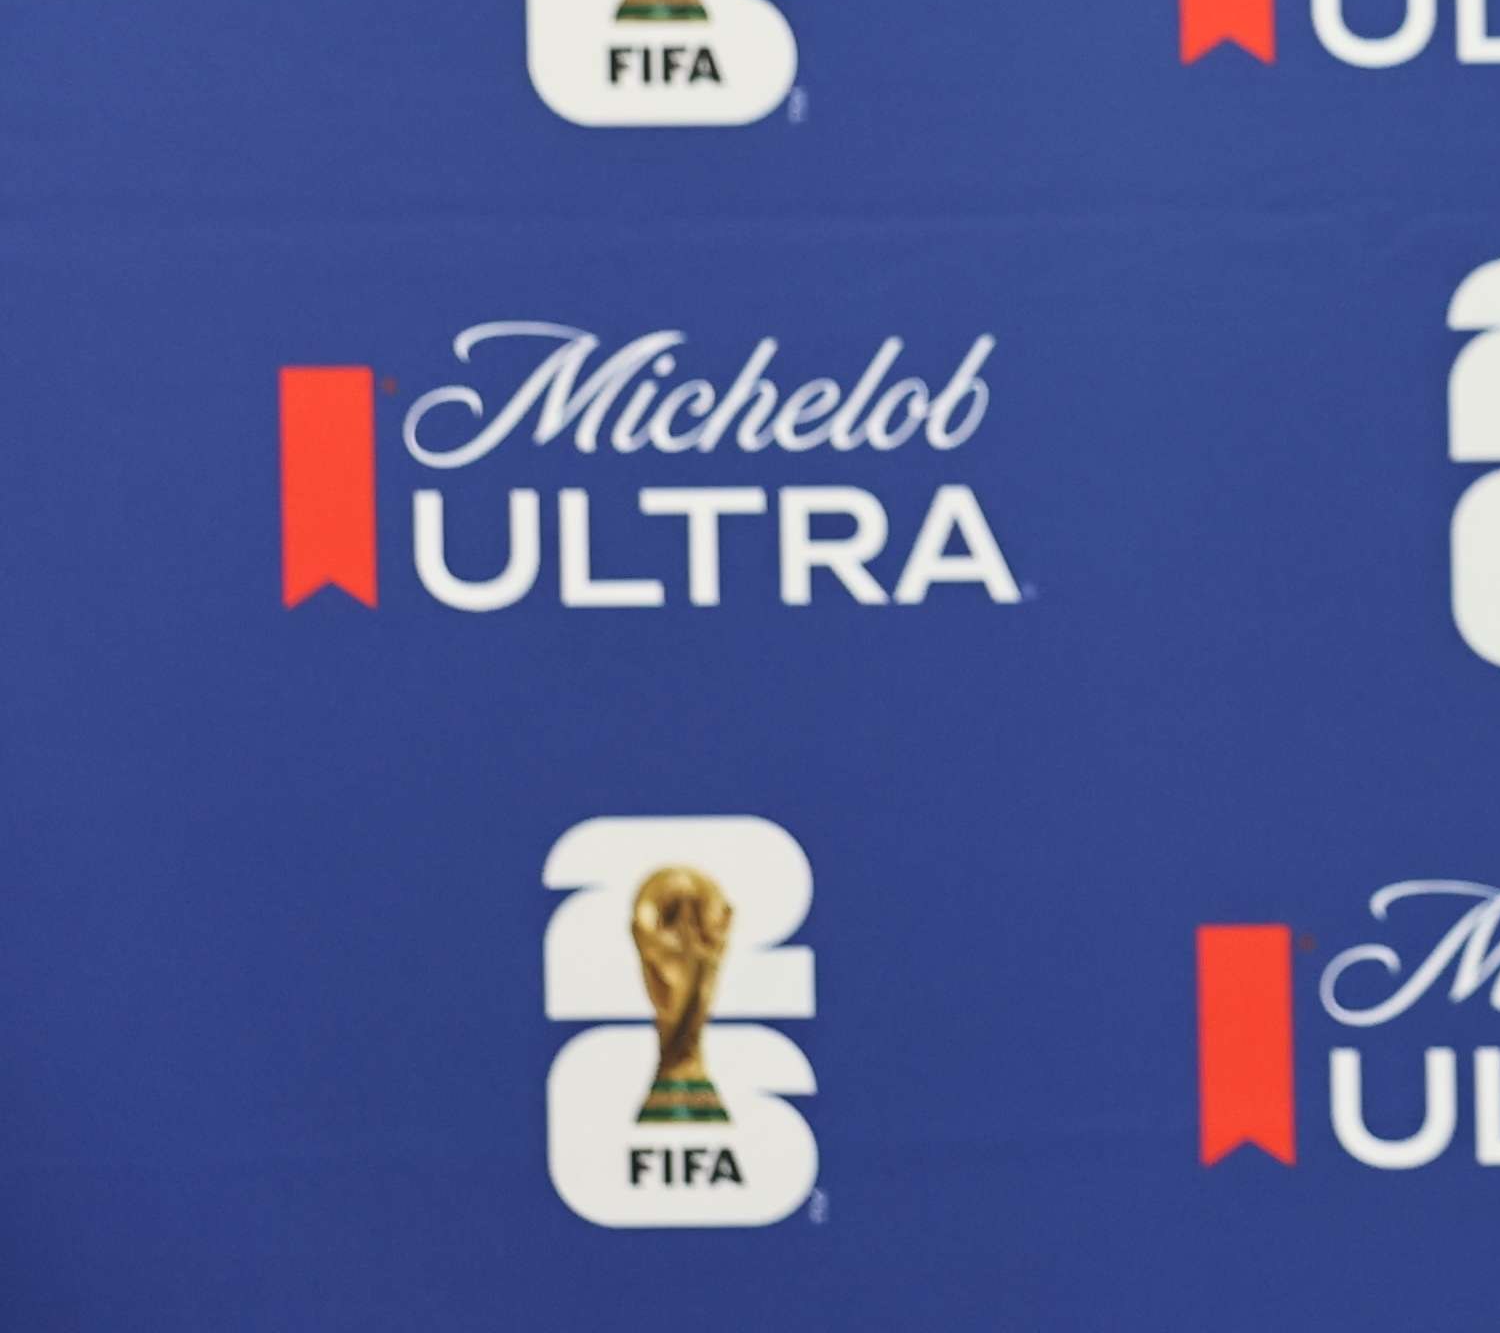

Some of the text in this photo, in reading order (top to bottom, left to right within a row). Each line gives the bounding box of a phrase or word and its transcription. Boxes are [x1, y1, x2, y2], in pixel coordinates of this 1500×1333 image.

[610, 47, 721, 84] FIFA
[404, 322, 995, 468] Michelob
[414, 485, 1020, 611] ULTRA
[630, 1148, 743, 1185] FIFA
